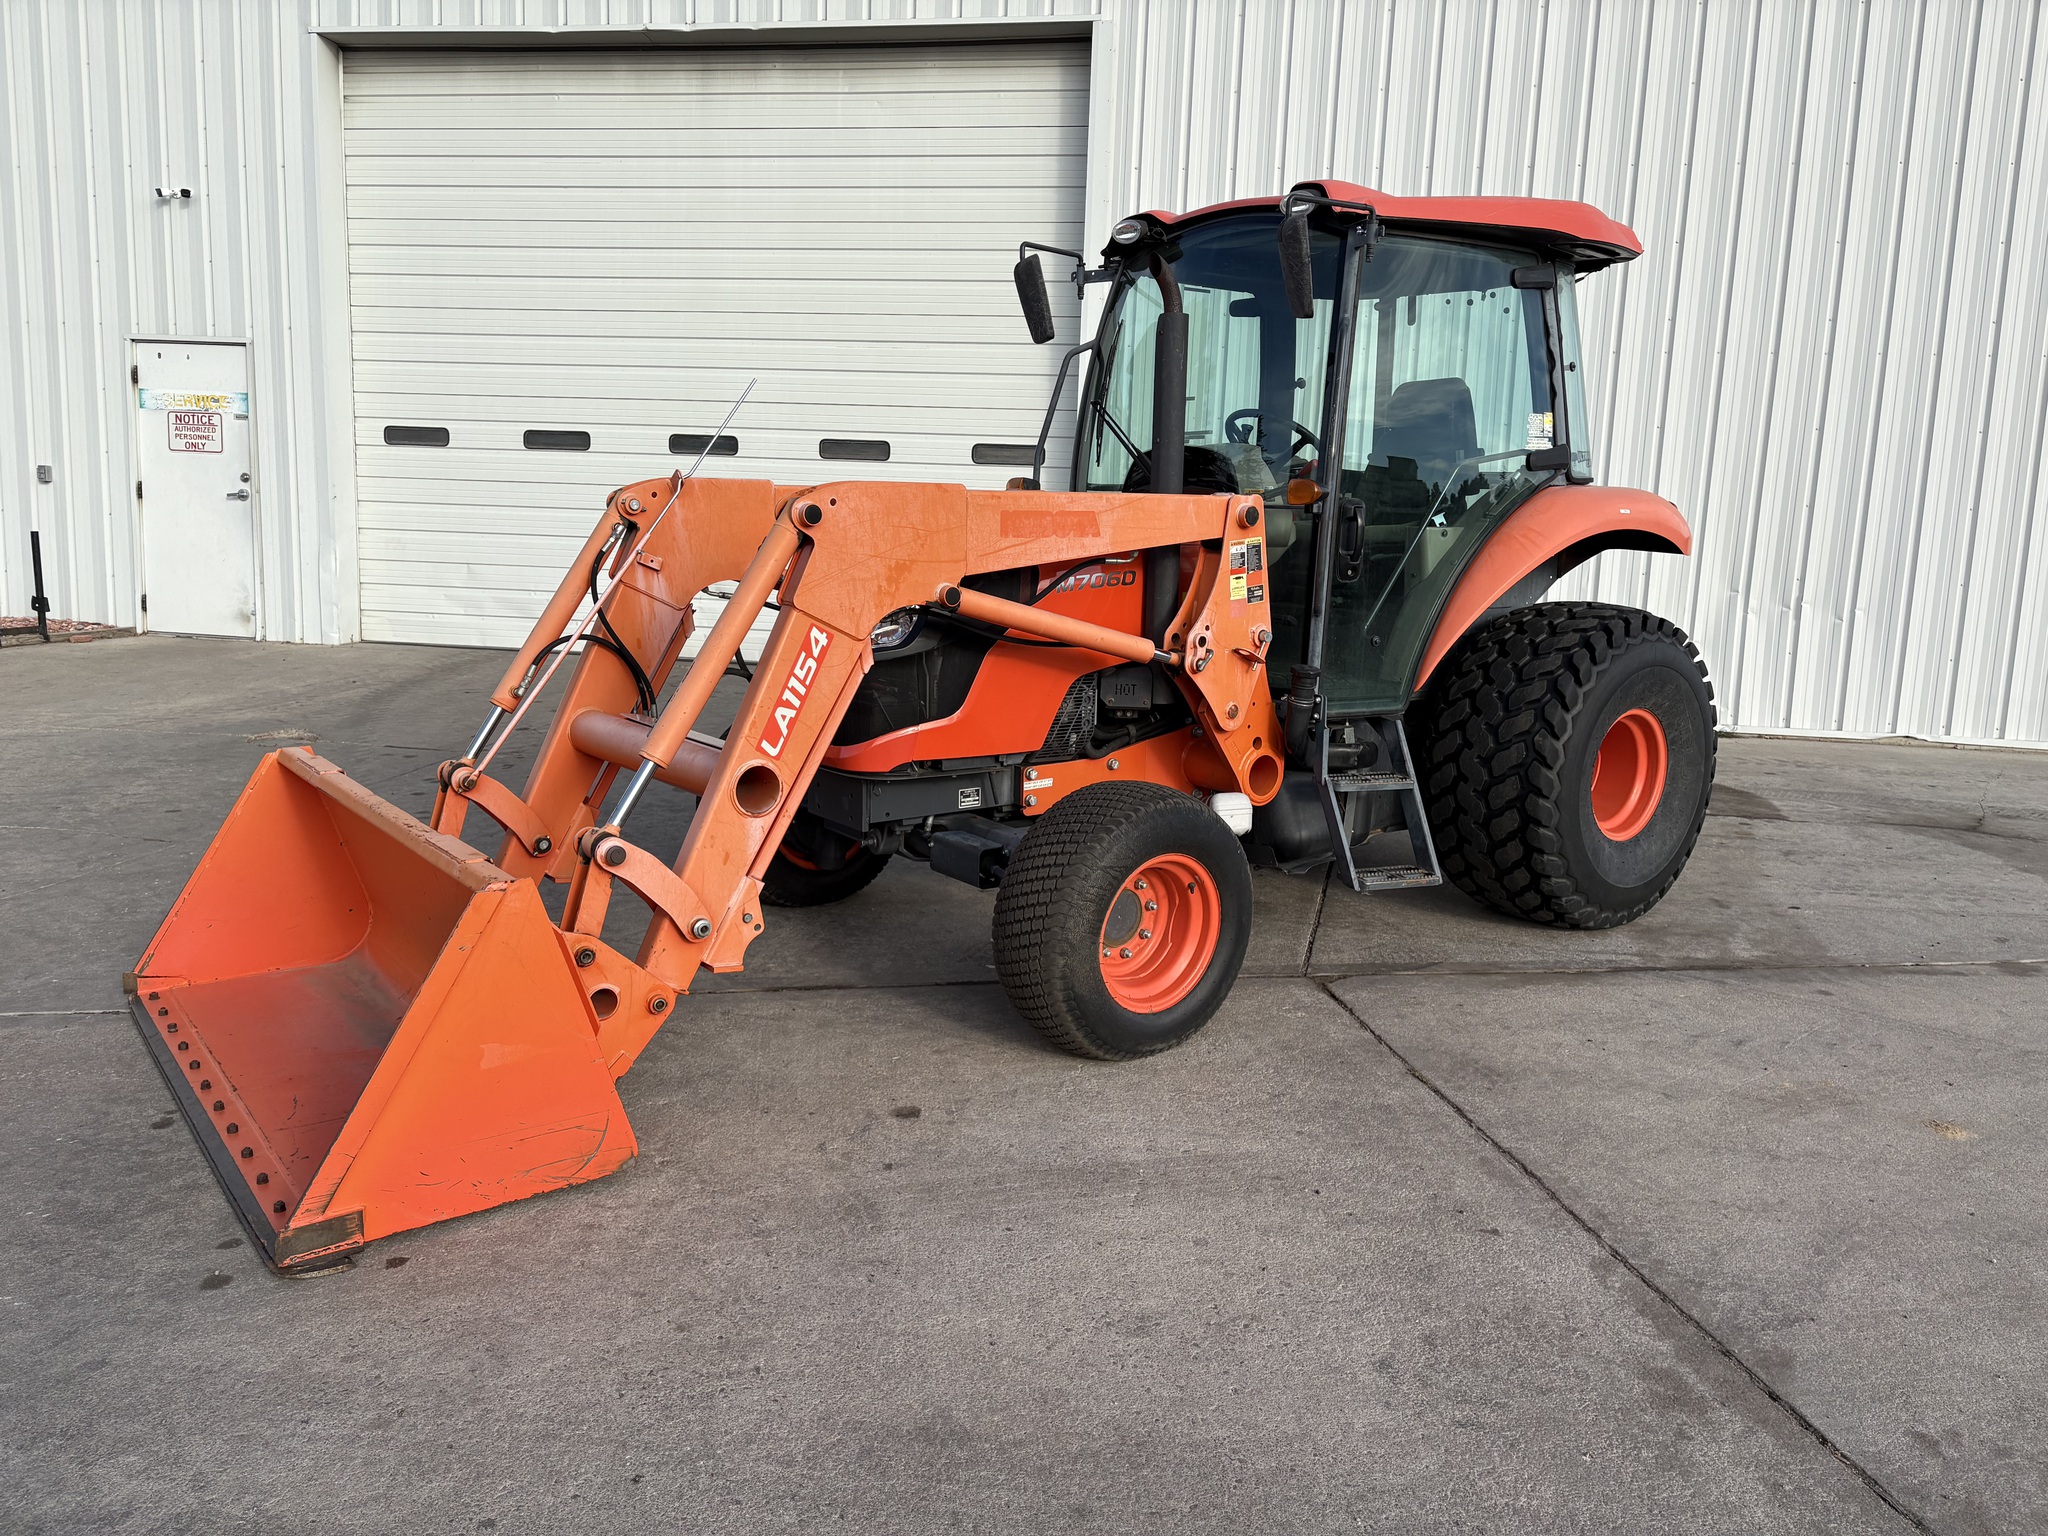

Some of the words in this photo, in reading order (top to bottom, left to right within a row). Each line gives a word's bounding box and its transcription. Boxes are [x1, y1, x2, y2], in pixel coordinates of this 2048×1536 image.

[164, 392, 229, 409] SERVICE
[174, 413, 215, 425] NOTICE
[174, 425, 217, 434] AUTHORIZED
[174, 433, 216, 441] PERSONNEL
[184, 441, 207, 450] ONLY
[1056, 570, 1137, 594] M7060
[760, 626, 829, 757] LA1154
[1115, 683, 1137, 696] HOT
